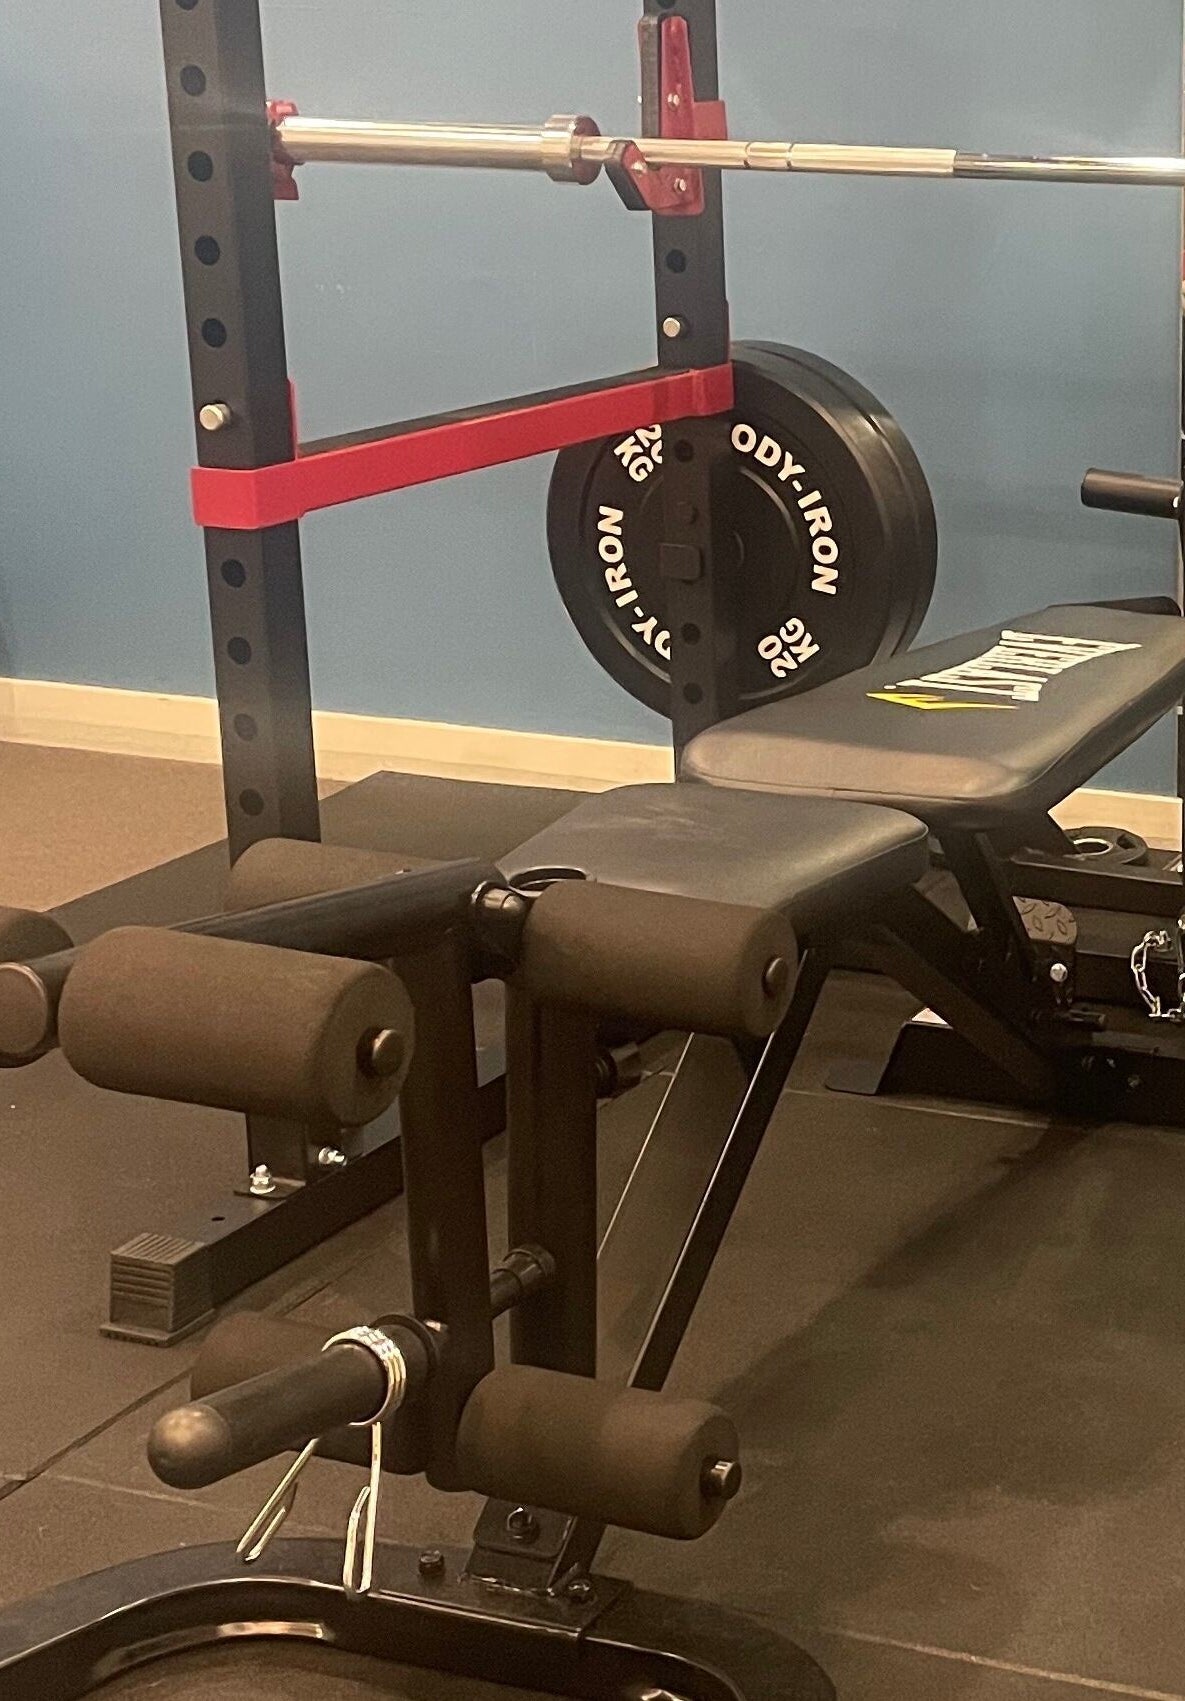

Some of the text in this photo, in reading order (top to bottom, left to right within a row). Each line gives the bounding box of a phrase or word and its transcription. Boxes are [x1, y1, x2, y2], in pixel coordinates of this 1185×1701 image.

[613, 435, 654, 482] KG
[730, 423, 840, 595] ODY-IRON
[597, 505, 671, 661] DY-IRON
[757, 635, 798, 679] 20
[779, 617, 820, 664] KG
[895, 629, 1143, 703] EVERLAST
